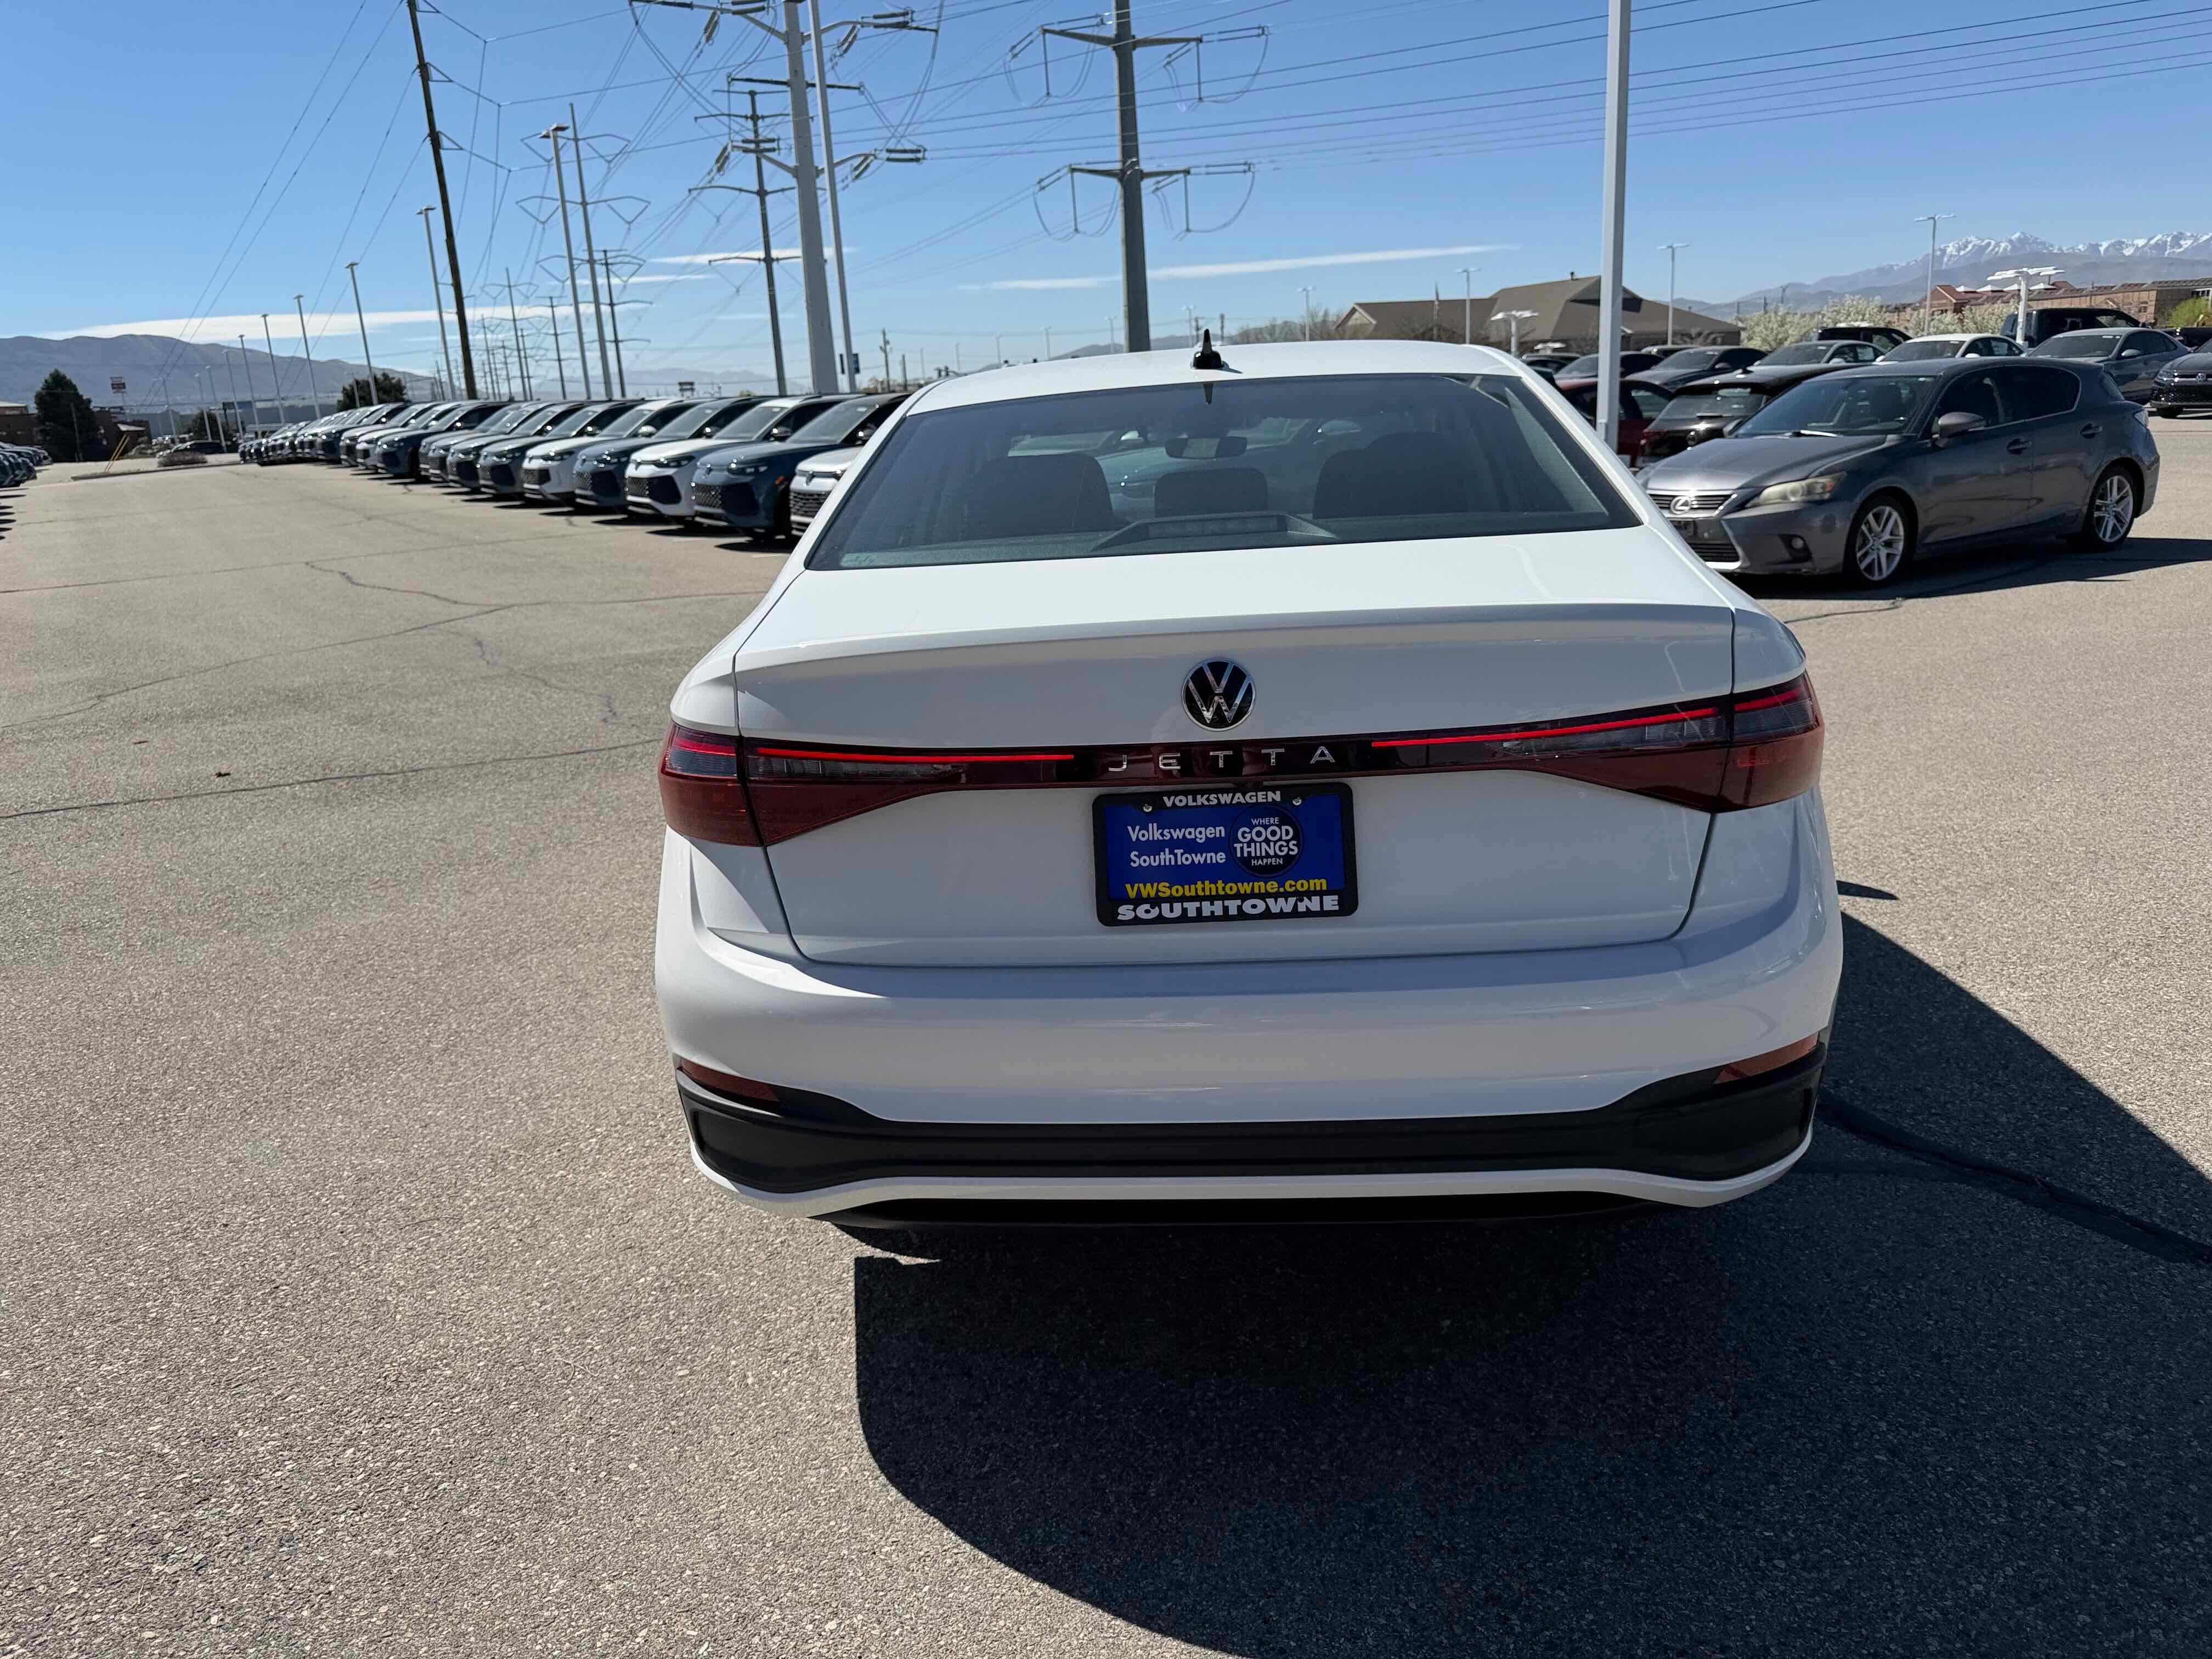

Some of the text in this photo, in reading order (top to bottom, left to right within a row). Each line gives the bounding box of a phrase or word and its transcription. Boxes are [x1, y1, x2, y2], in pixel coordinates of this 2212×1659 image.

[1108, 746, 1336, 772] JETTA
[1163, 791, 1282, 807] VOLKSWAGEN
[1251, 817, 1280, 825] WHERE
[1127, 823, 1225, 843] Volkswagen
[1237, 826, 1294, 842] GOOD
[1130, 848, 1226, 867] SouthTowne
[1234, 840, 1299, 857] THINGS
[1251, 857, 1283, 866] HAPPEN
[1125, 878, 1327, 899] VWSouthtowne.com
[1117, 895, 1339, 921] SOUTHTOWNE
